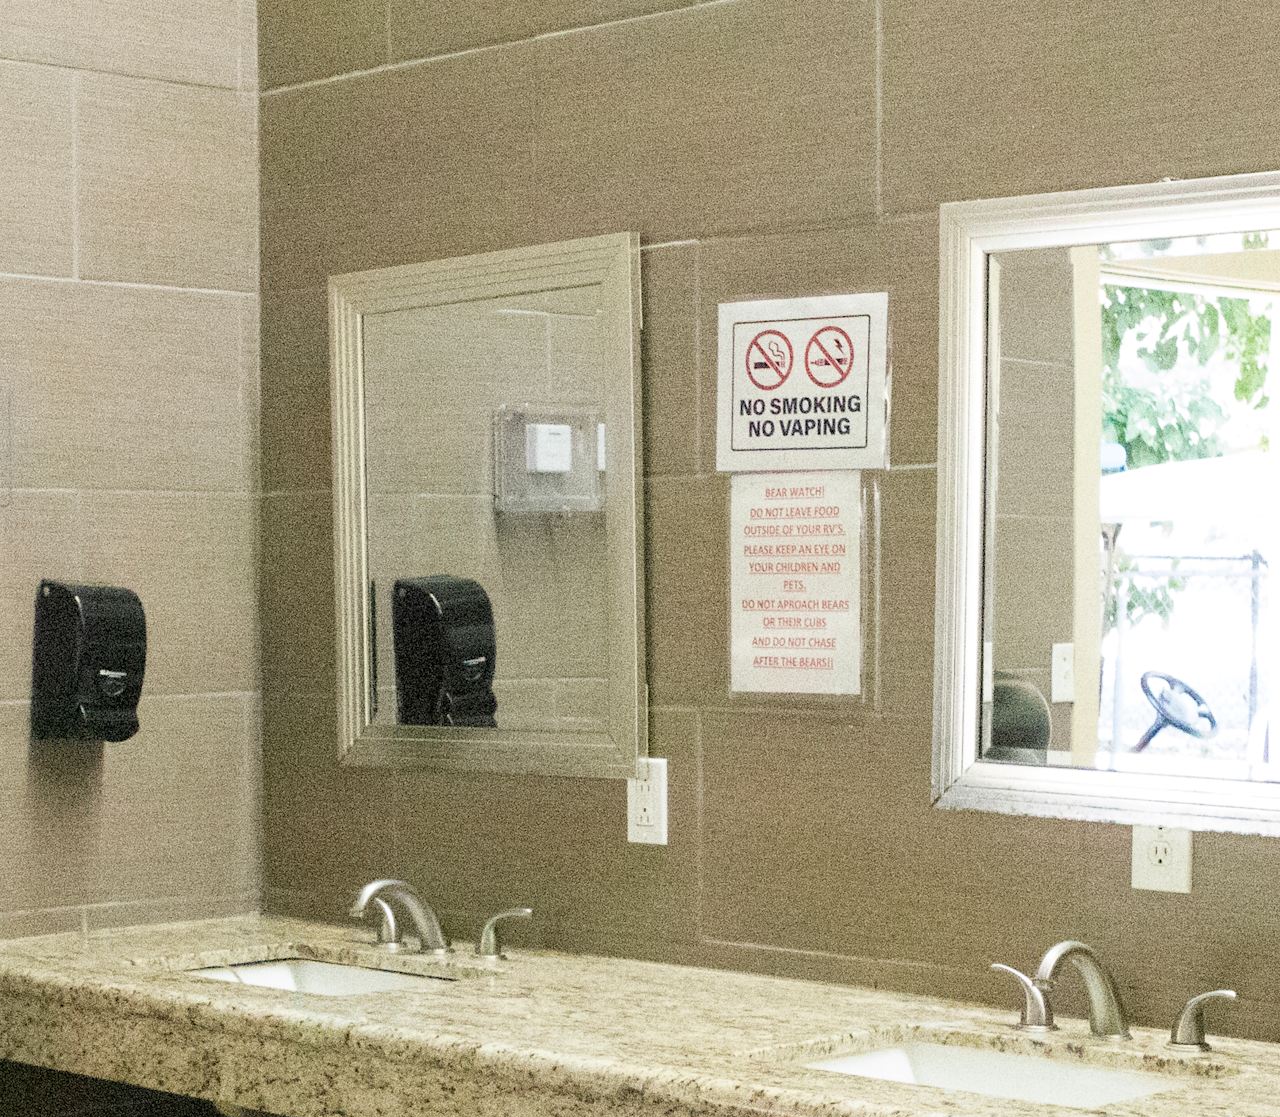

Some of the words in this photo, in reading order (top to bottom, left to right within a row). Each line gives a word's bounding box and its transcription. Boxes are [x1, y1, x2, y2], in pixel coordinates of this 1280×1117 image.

[739, 399, 765, 416] NO
[770, 395, 861, 415] SMOKING
[748, 420, 775, 437] NO
[779, 418, 851, 437] VAPING
[765, 487, 787, 498] BEAR
[789, 485, 825, 497] WATCH!
[750, 507, 763, 518] DO
[765, 507, 783, 517] NOT
[785, 507, 812, 517] LEAVE
[814, 506, 840, 516] FOOD
[743, 525, 780, 536] OUTSIDE
[782, 525, 794, 535] OF
[796, 524, 821, 534] YOUR
[743, 545, 773, 555] PLEASE
[775, 545, 797, 555] KEEP
[798, 544, 812, 554] AN
[814, 544, 829, 554] EYE
[831, 544, 846, 554] ON
[749, 562, 773, 572] YOUR
[775, 562, 818, 572] CHILDREN
[821, 562, 841, 572] AND
[741, 599, 755, 609] DO
[757, 599, 775, 609] NOT
[821, 600, 849, 610] BEARS
[763, 617, 776, 627] OR
[777, 617, 802, 627] THEIR
[804, 617, 827, 627] CUBS
[752, 637, 770, 646] AND
[772, 637, 786, 646] DO
[788, 637, 806, 647] NOT
[808, 637, 836, 648] CHASE
[753, 656, 779, 666] AFTER
[781, 656, 797, 667] THE
